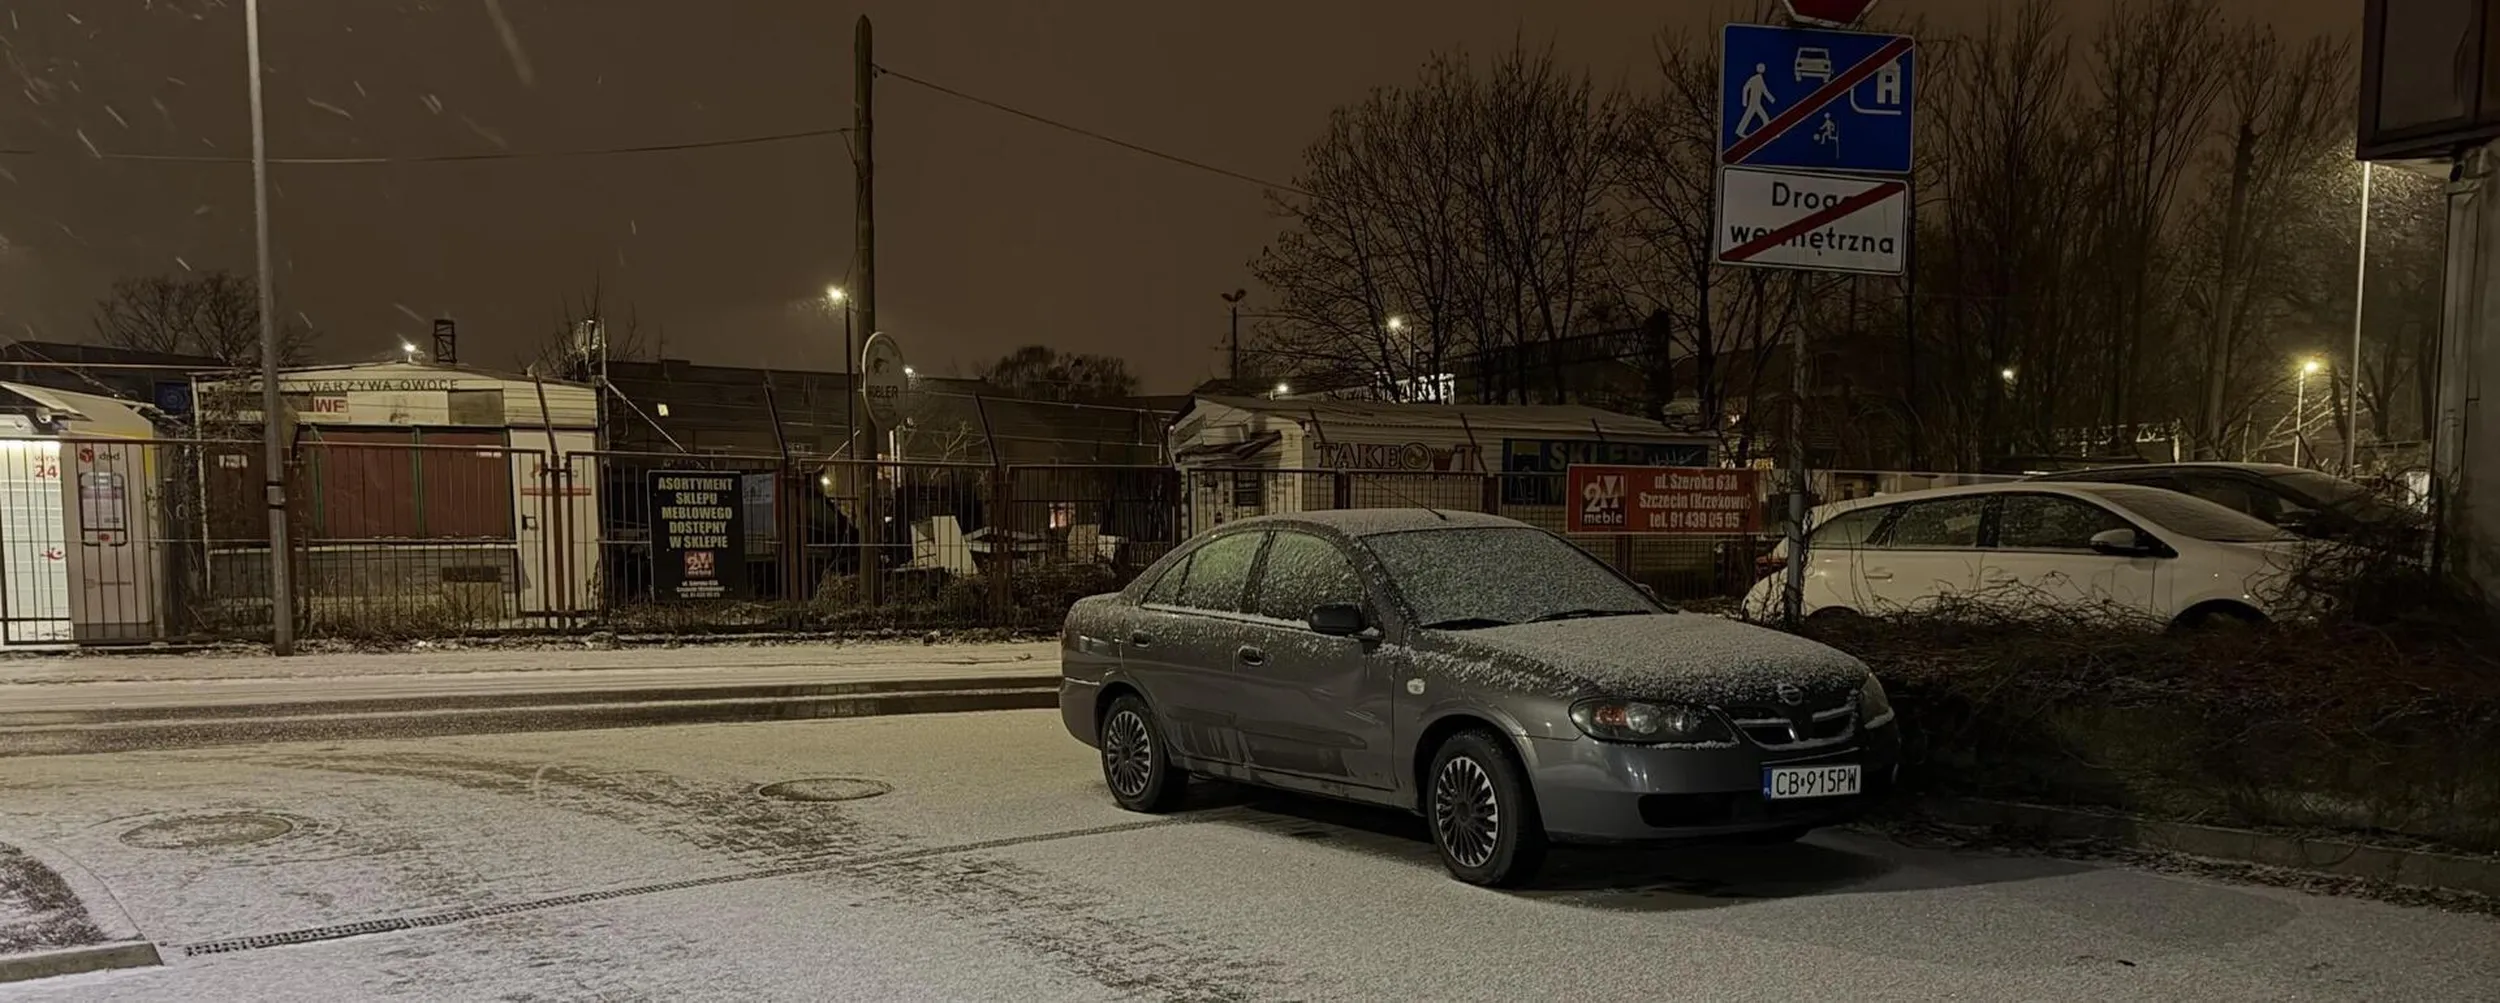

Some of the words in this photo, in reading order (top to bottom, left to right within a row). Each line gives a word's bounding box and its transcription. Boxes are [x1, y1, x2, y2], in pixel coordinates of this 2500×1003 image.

[1771, 182, 1854, 211] Drog
[1730, 226, 1895, 256] wenętrzna
[308, 381, 393, 393] WARZYWA
[400, 379, 458, 391] OWOCE
[658, 477, 733, 491] ASORTYMENT
[1654, 474, 1668, 490] ul.
[1671, 474, 1713, 491] Szeroka
[1716, 475, 1738, 491] 63A
[675, 492, 718, 505] SKLEPU
[1639, 492, 1688, 509] Szczecin
[661, 506, 733, 520] MEBLOWEGO
[1583, 512, 1624, 525] meble
[1650, 511, 1668, 528] tel.
[1684, 512, 1706, 528] 439
[1725, 512, 1739, 528] 05
[669, 521, 727, 535] DOSTĘPNY
[669, 536, 682, 549] W
[683, 536, 729, 549] SKLEPIE
